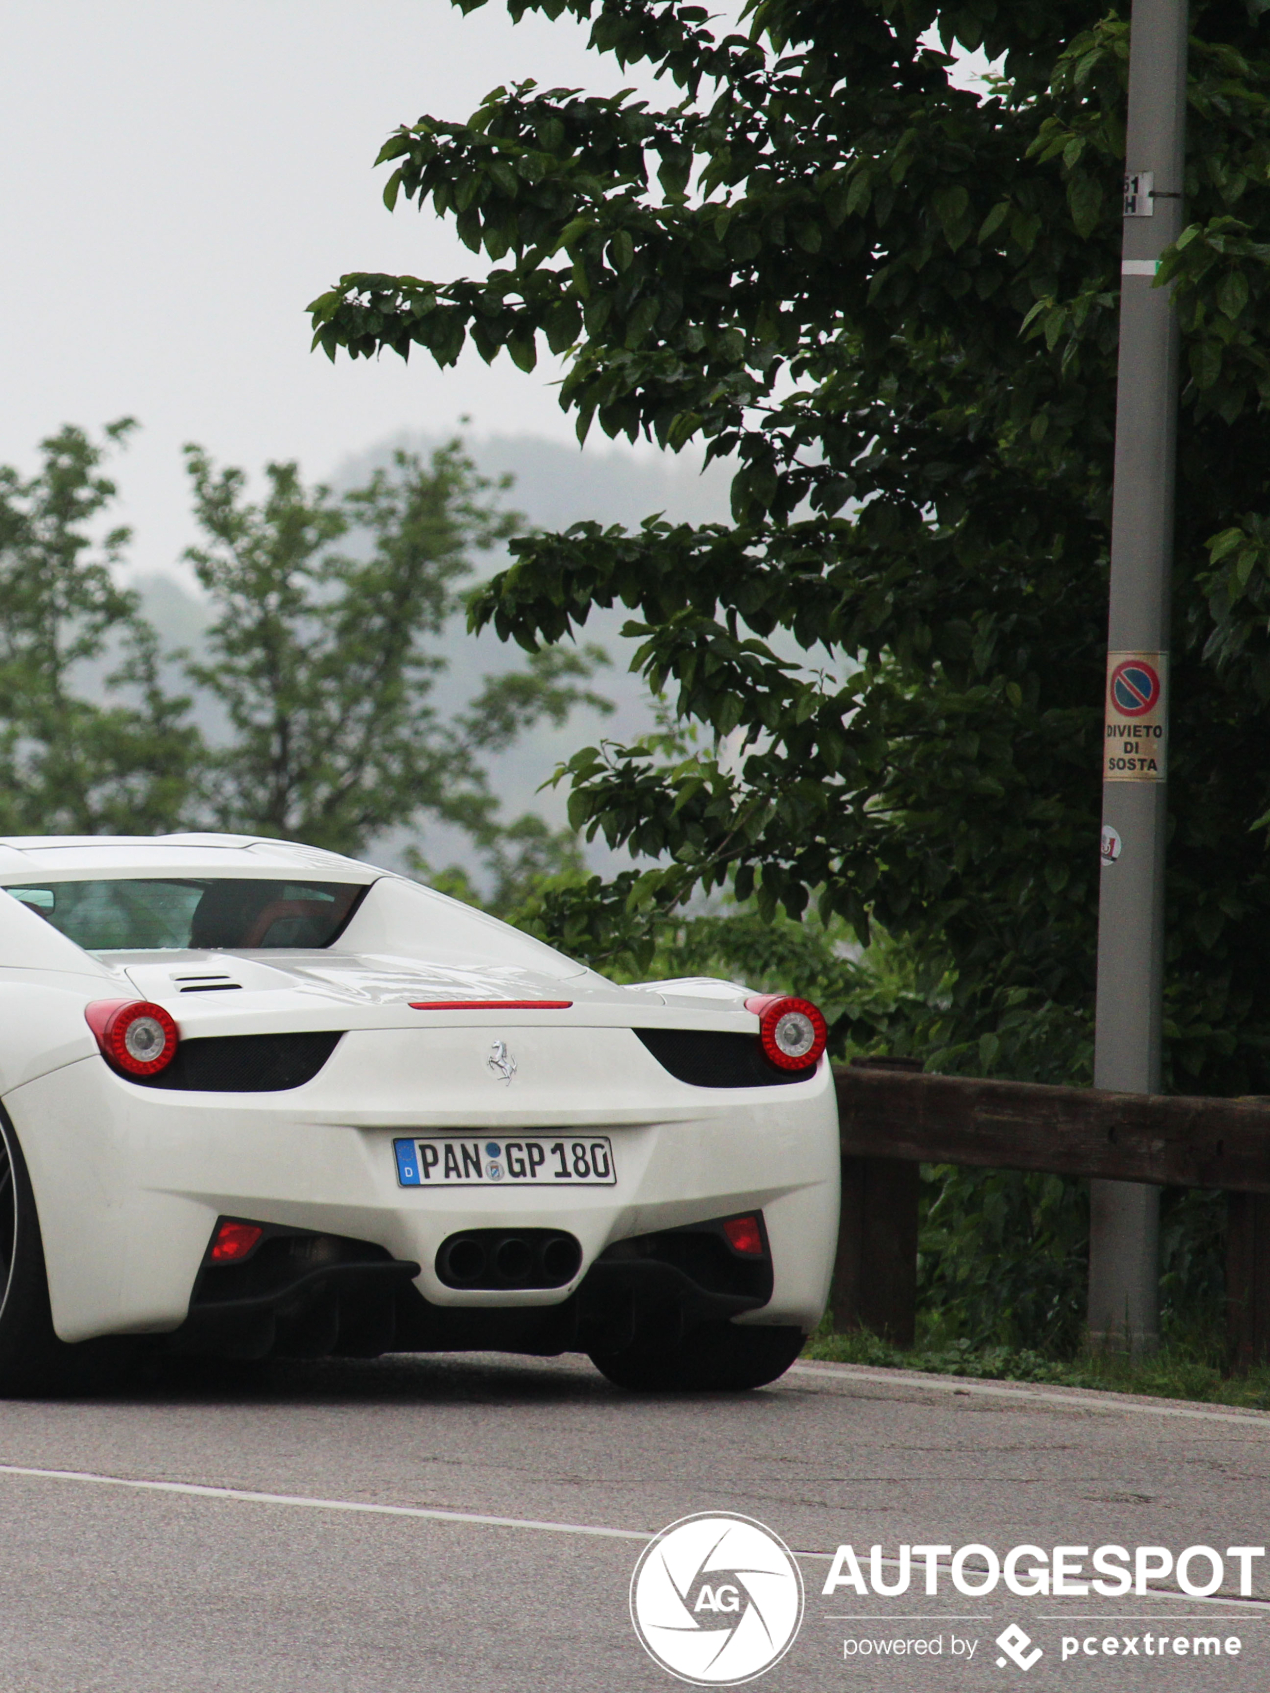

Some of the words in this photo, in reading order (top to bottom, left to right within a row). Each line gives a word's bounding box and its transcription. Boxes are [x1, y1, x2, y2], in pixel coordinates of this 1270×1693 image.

[1106, 724, 1163, 738] DIVIETO
[1123, 742, 1140, 754] DI
[1108, 758, 1158, 771] SOSTA
[418, 1143, 484, 1179] PAN
[504, 1142, 546, 1178] GP
[550, 1142, 611, 1179] 180
[404, 1167, 413, 1178] D
